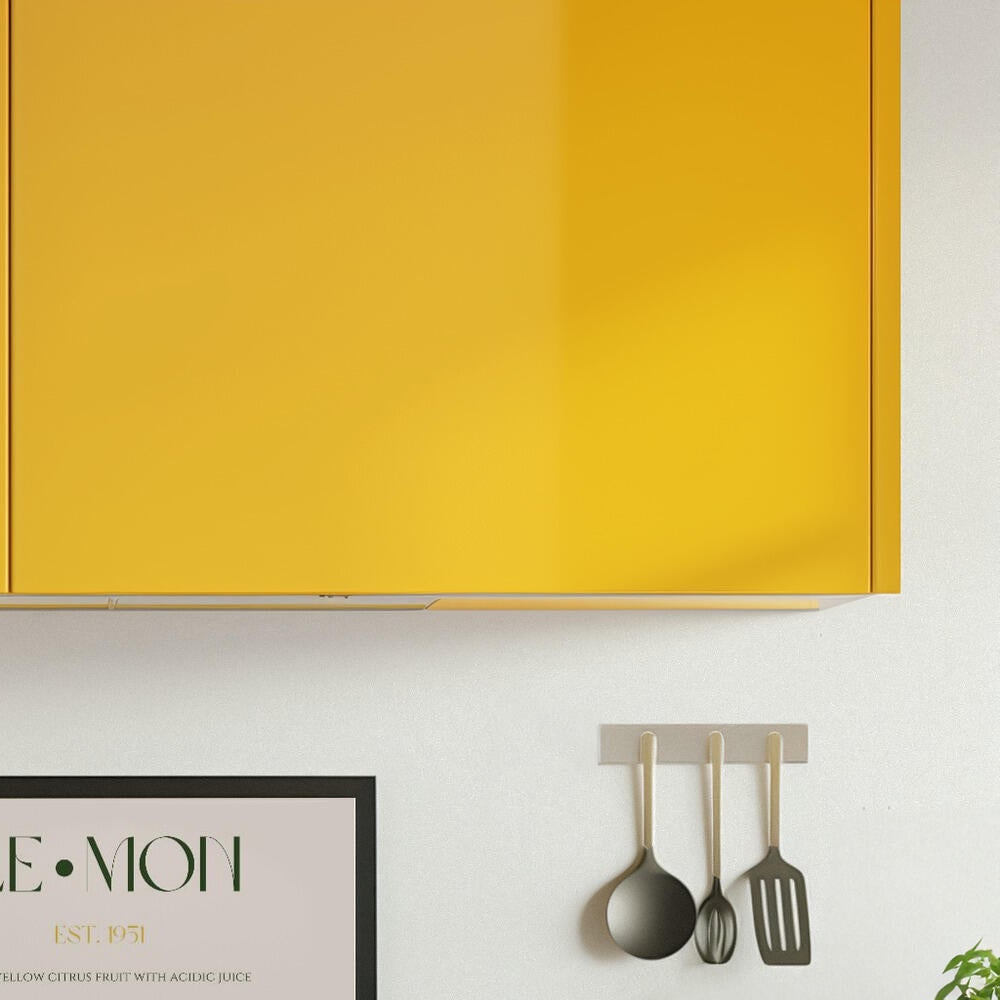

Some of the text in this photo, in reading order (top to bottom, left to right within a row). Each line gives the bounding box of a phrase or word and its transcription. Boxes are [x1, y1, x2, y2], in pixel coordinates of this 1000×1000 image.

[54, 924, 100, 945] EST.
[47, 970, 92, 983] CITRUS
[95, 970, 131, 983] FRUIT
[134, 970, 167, 983] WITH
[170, 970, 216, 983] ACIDIC
[217, 970, 252, 985] JUICE
